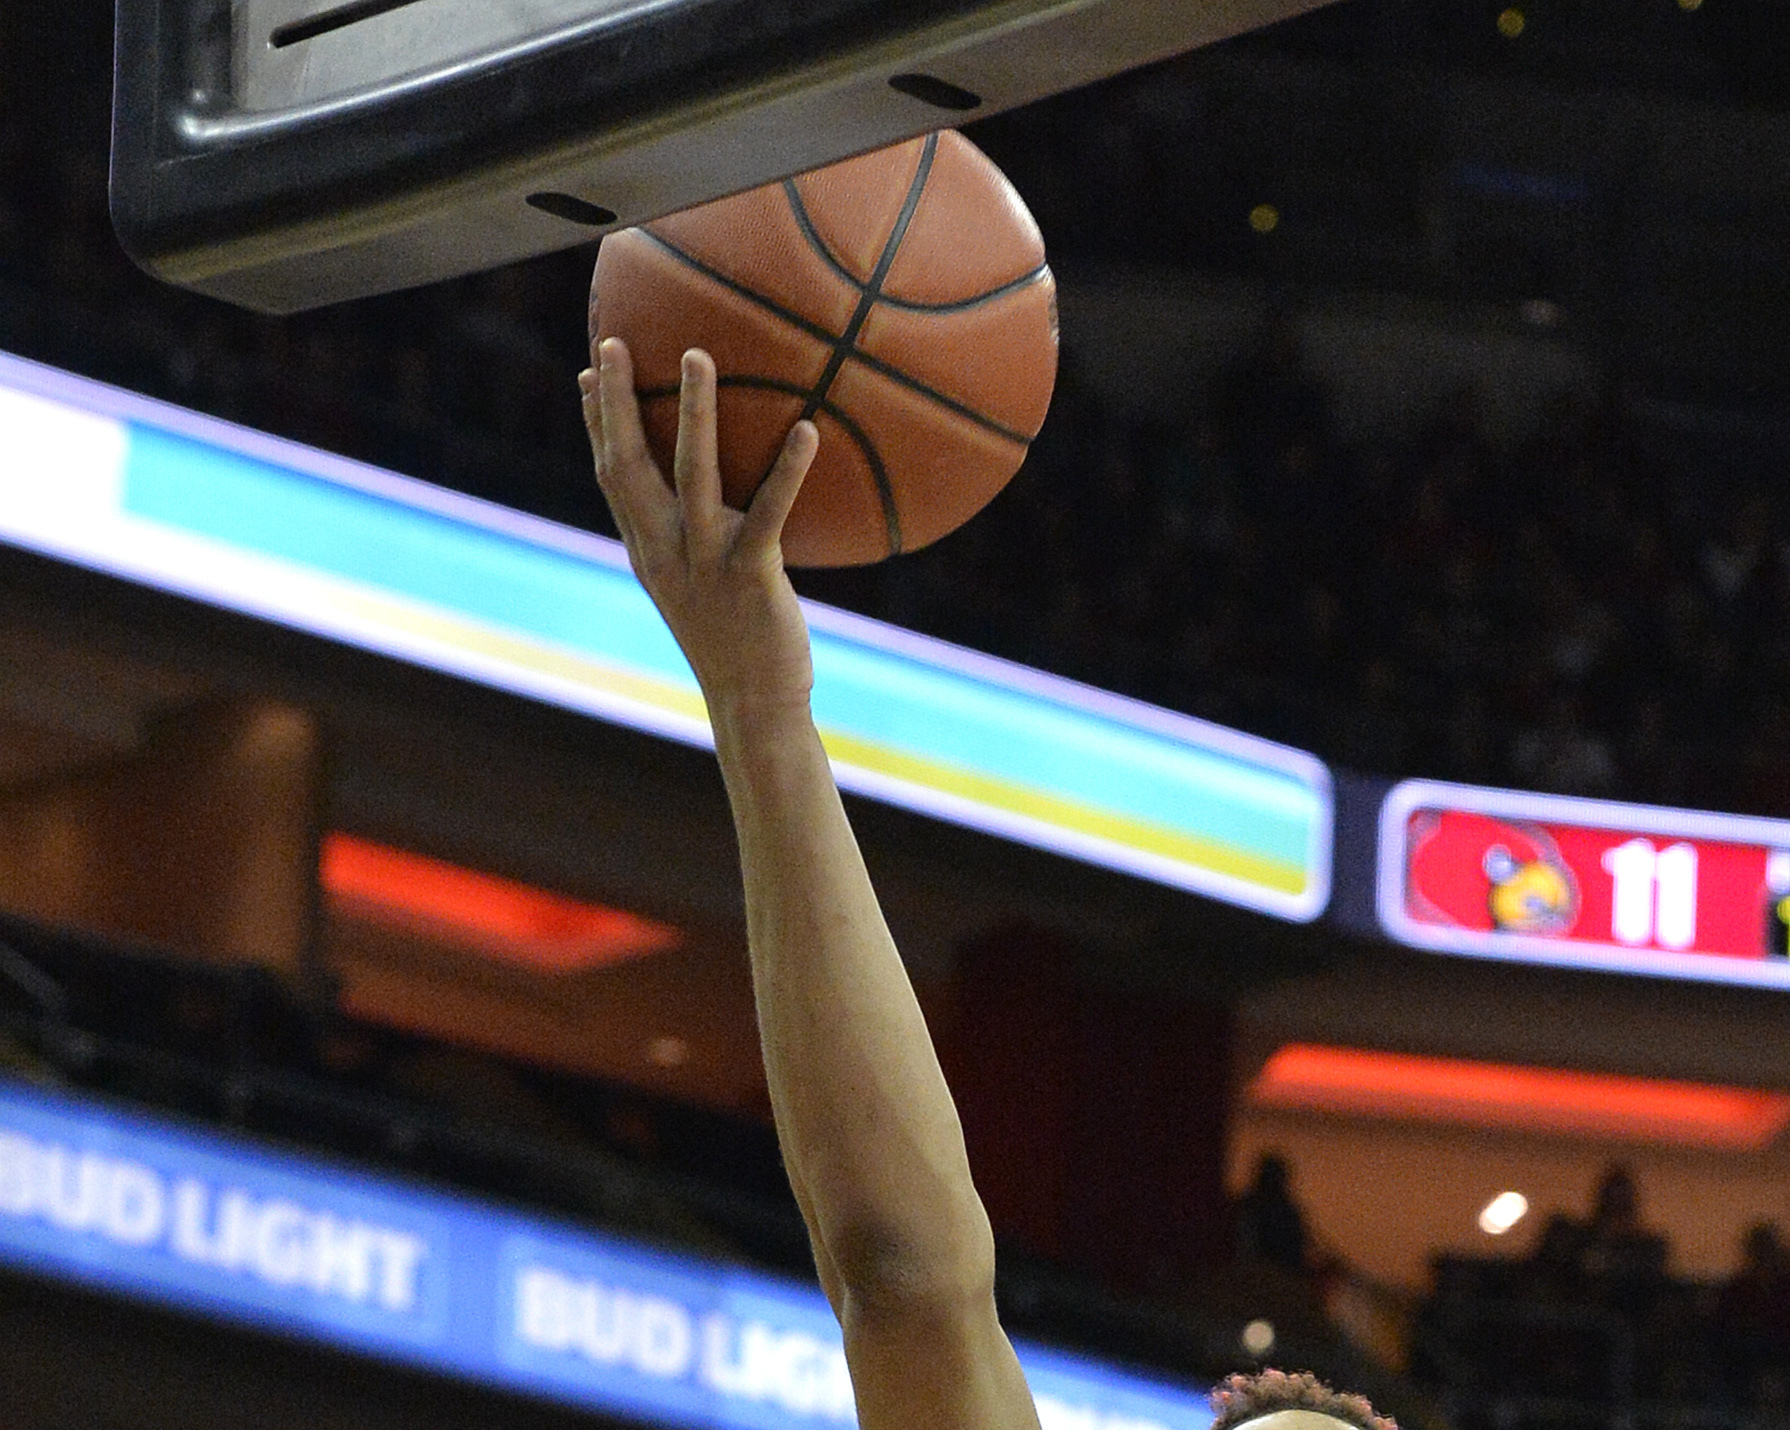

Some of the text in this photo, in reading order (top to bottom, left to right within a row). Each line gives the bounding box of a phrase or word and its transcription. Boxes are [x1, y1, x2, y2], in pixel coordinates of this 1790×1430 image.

[1602, 838, 1698, 949] 11
[170, 1178, 425, 1313] LIGHT
[516, 1265, 855, 1415] BUD LIG
